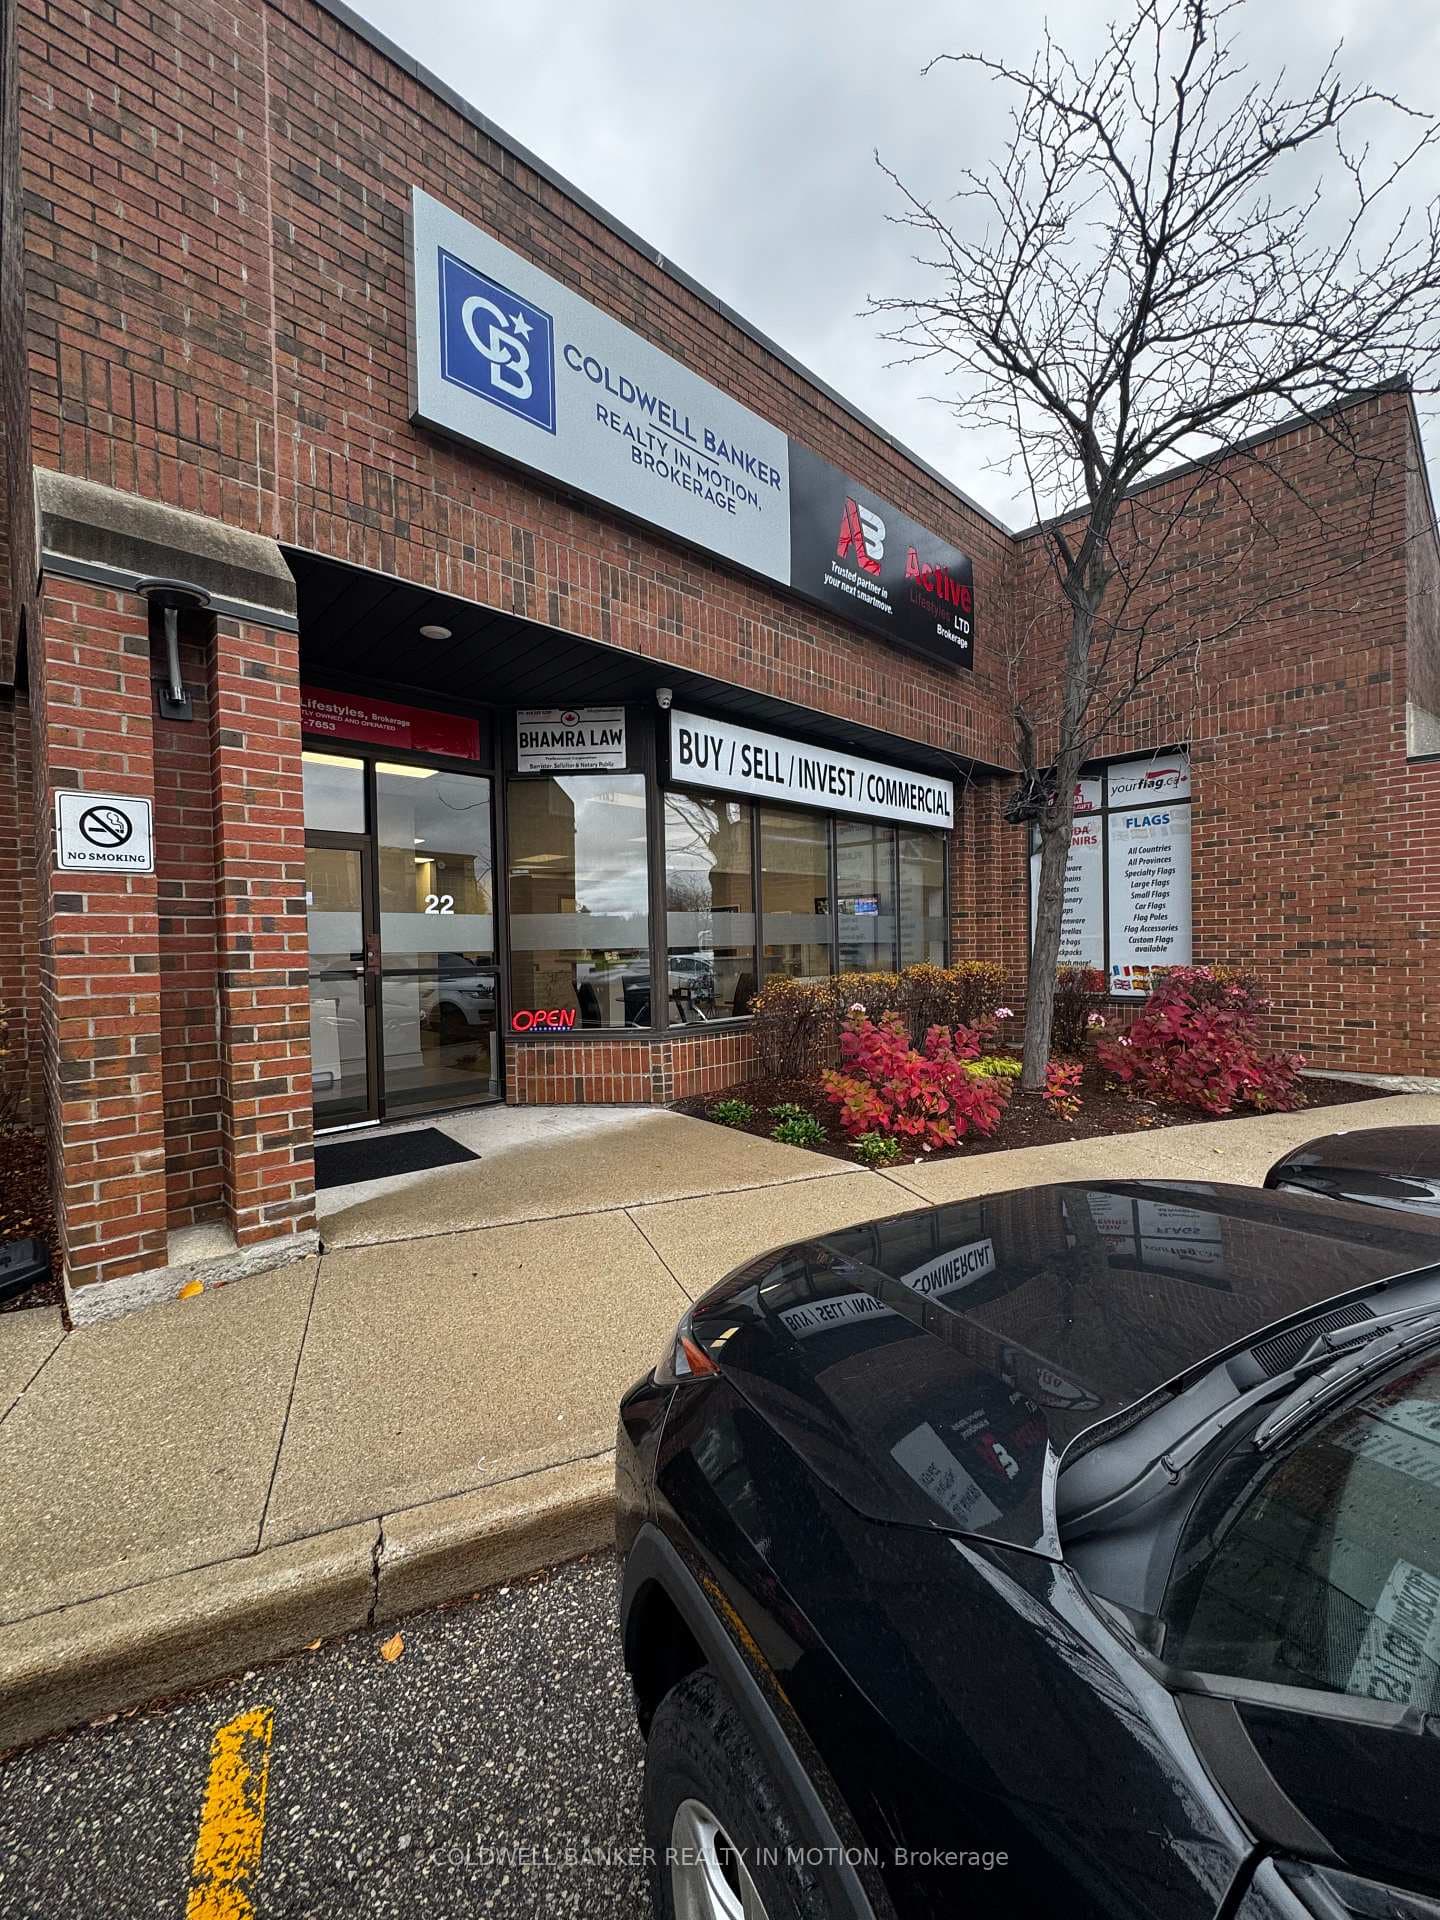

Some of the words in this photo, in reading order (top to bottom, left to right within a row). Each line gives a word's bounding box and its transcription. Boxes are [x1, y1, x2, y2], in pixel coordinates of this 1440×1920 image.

[563, 344, 697, 443] COLDWELL
[704, 428, 782, 491] BANKER
[596, 403, 668, 457] REALTY
[674, 448, 691, 471] IN
[697, 463, 762, 511] MOTION,
[632, 445, 736, 515] BROKERAGE
[824, 573, 841, 588] your
[841, 579, 857, 595] next
[831, 560, 857, 583] Trusted
[856, 575, 881, 595] partner
[881, 587, 888, 599] in
[905, 545, 972, 614] Active
[954, 616, 970, 634] LTD
[936, 624, 968, 649] Brokerage
[300, 698, 369, 720] Lifestyles,
[371, 713, 411, 728] Brokerage
[344, 718, 360, 727] AND
[519, 730, 586, 748] BHAMRA
[590, 729, 623, 746] LAW
[678, 728, 724, 772] BUY
[741, 744, 785, 784] SELL
[798, 758, 856, 799] INVEST
[866, 774, 951, 817] COMMERCIAL
[1126, 814, 1170, 829] FLAGS
[67, 852, 87, 860] NO
[88, 852, 146, 863] SMOKING
[1128, 847, 1138, 855] All
[1138, 845, 1172, 854] Countries
[1128, 858, 1138, 866] All
[1138, 857, 1172, 866] Provinces
[1124, 868, 1156, 879] Specialty
[1156, 867, 1176, 877] Flags
[1130, 881, 1150, 890] Large
[1150, 880, 1170, 888] Flags
[1130, 891, 1150, 899] Small
[1151, 890, 1170, 899] Flags
[424, 894, 455, 915] 22
[1134, 902, 1147, 910] Car
[1147, 902, 1167, 911] Flags
[1133, 914, 1149, 923] Flag
[1149, 913, 1168, 921] Poles
[1123, 925, 1139, 935] Flag
[1139, 924, 1179, 933] Accessories
[1128, 936, 1154, 944] Custom
[1154, 936, 1174, 945] Flags
[1134, 945, 1168, 953] available
[511, 1007, 577, 1032] OPEN
